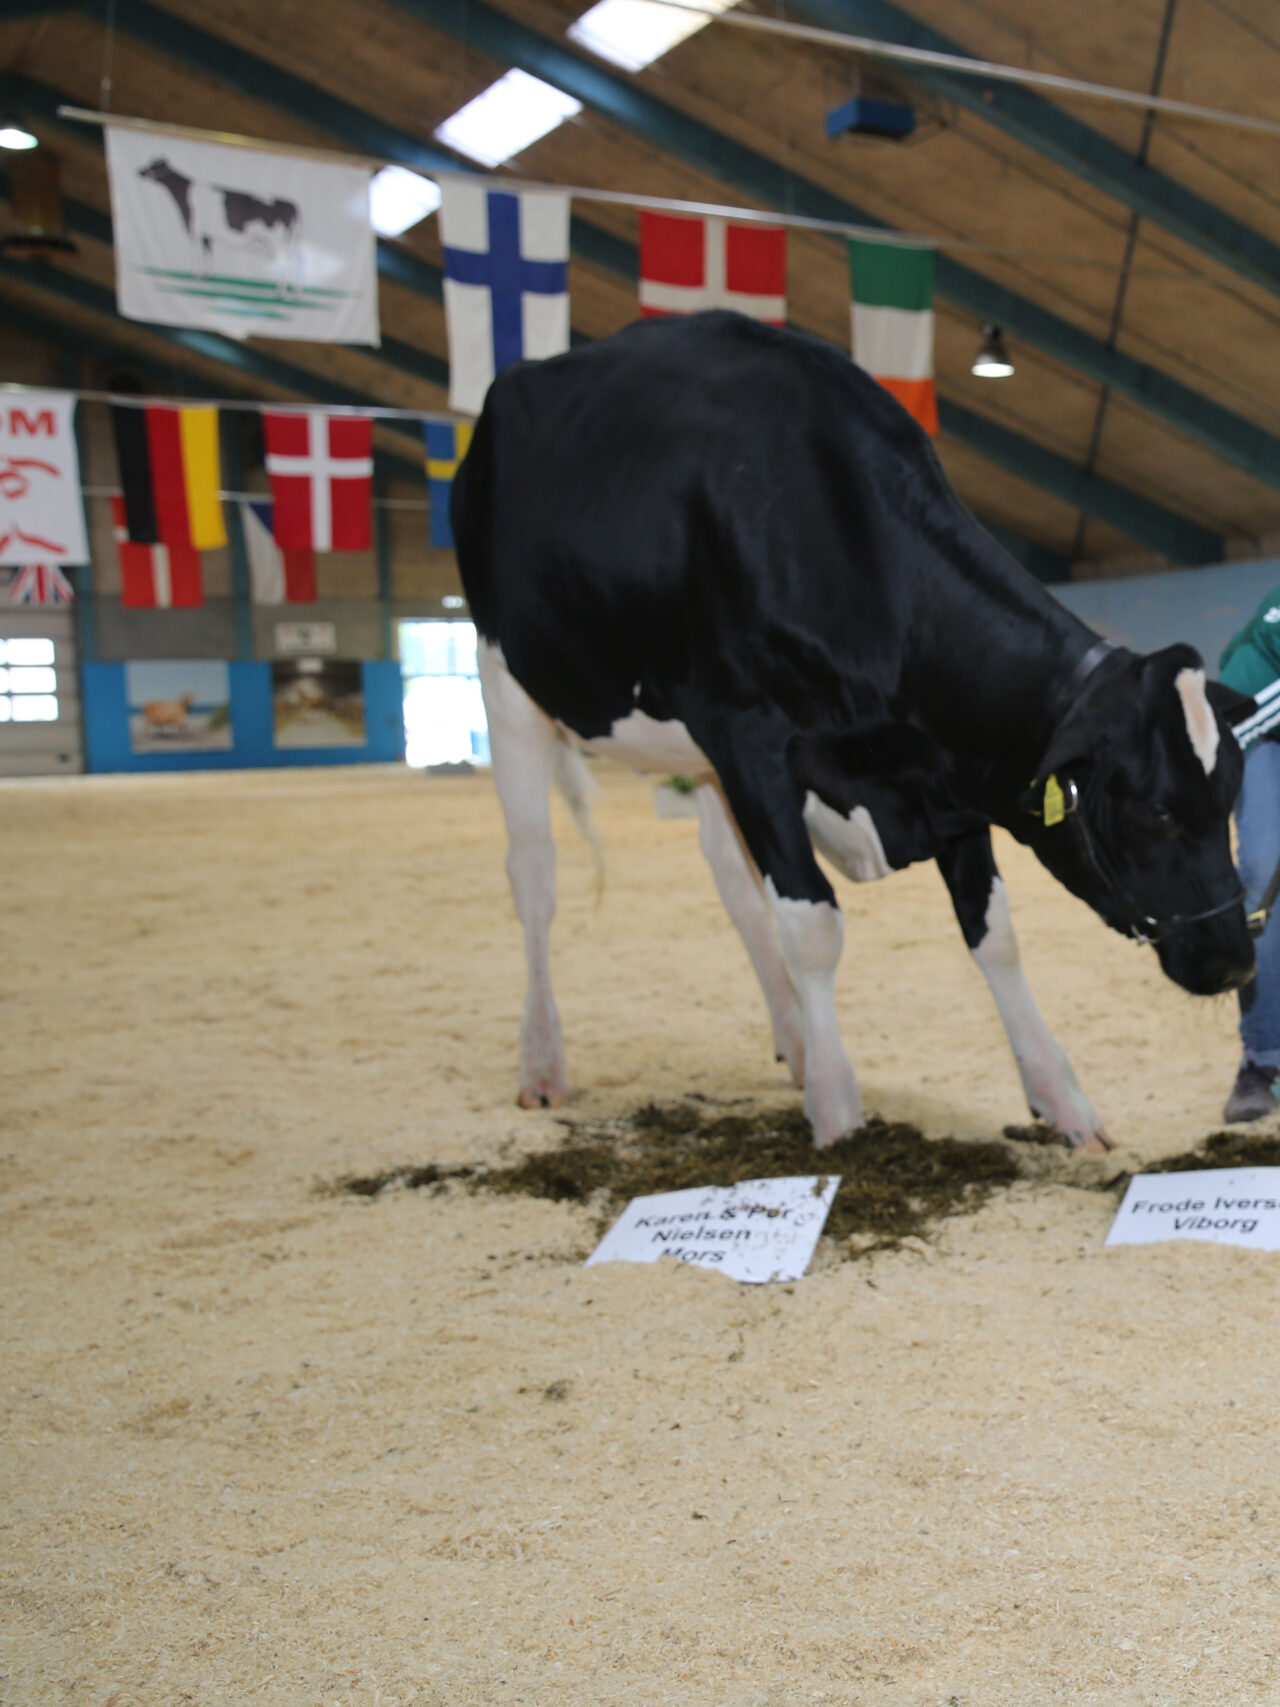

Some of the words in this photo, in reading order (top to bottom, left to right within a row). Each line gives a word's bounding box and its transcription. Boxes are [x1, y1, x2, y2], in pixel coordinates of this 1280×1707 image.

[0, 409, 57, 438] M
[1131, 1198, 1205, 1214] Frode
[634, 1209, 711, 1229] Karen
[720, 1206, 737, 1221] &
[1173, 1216, 1259, 1233] Viborg
[651, 1226, 752, 1243] Nielsen
